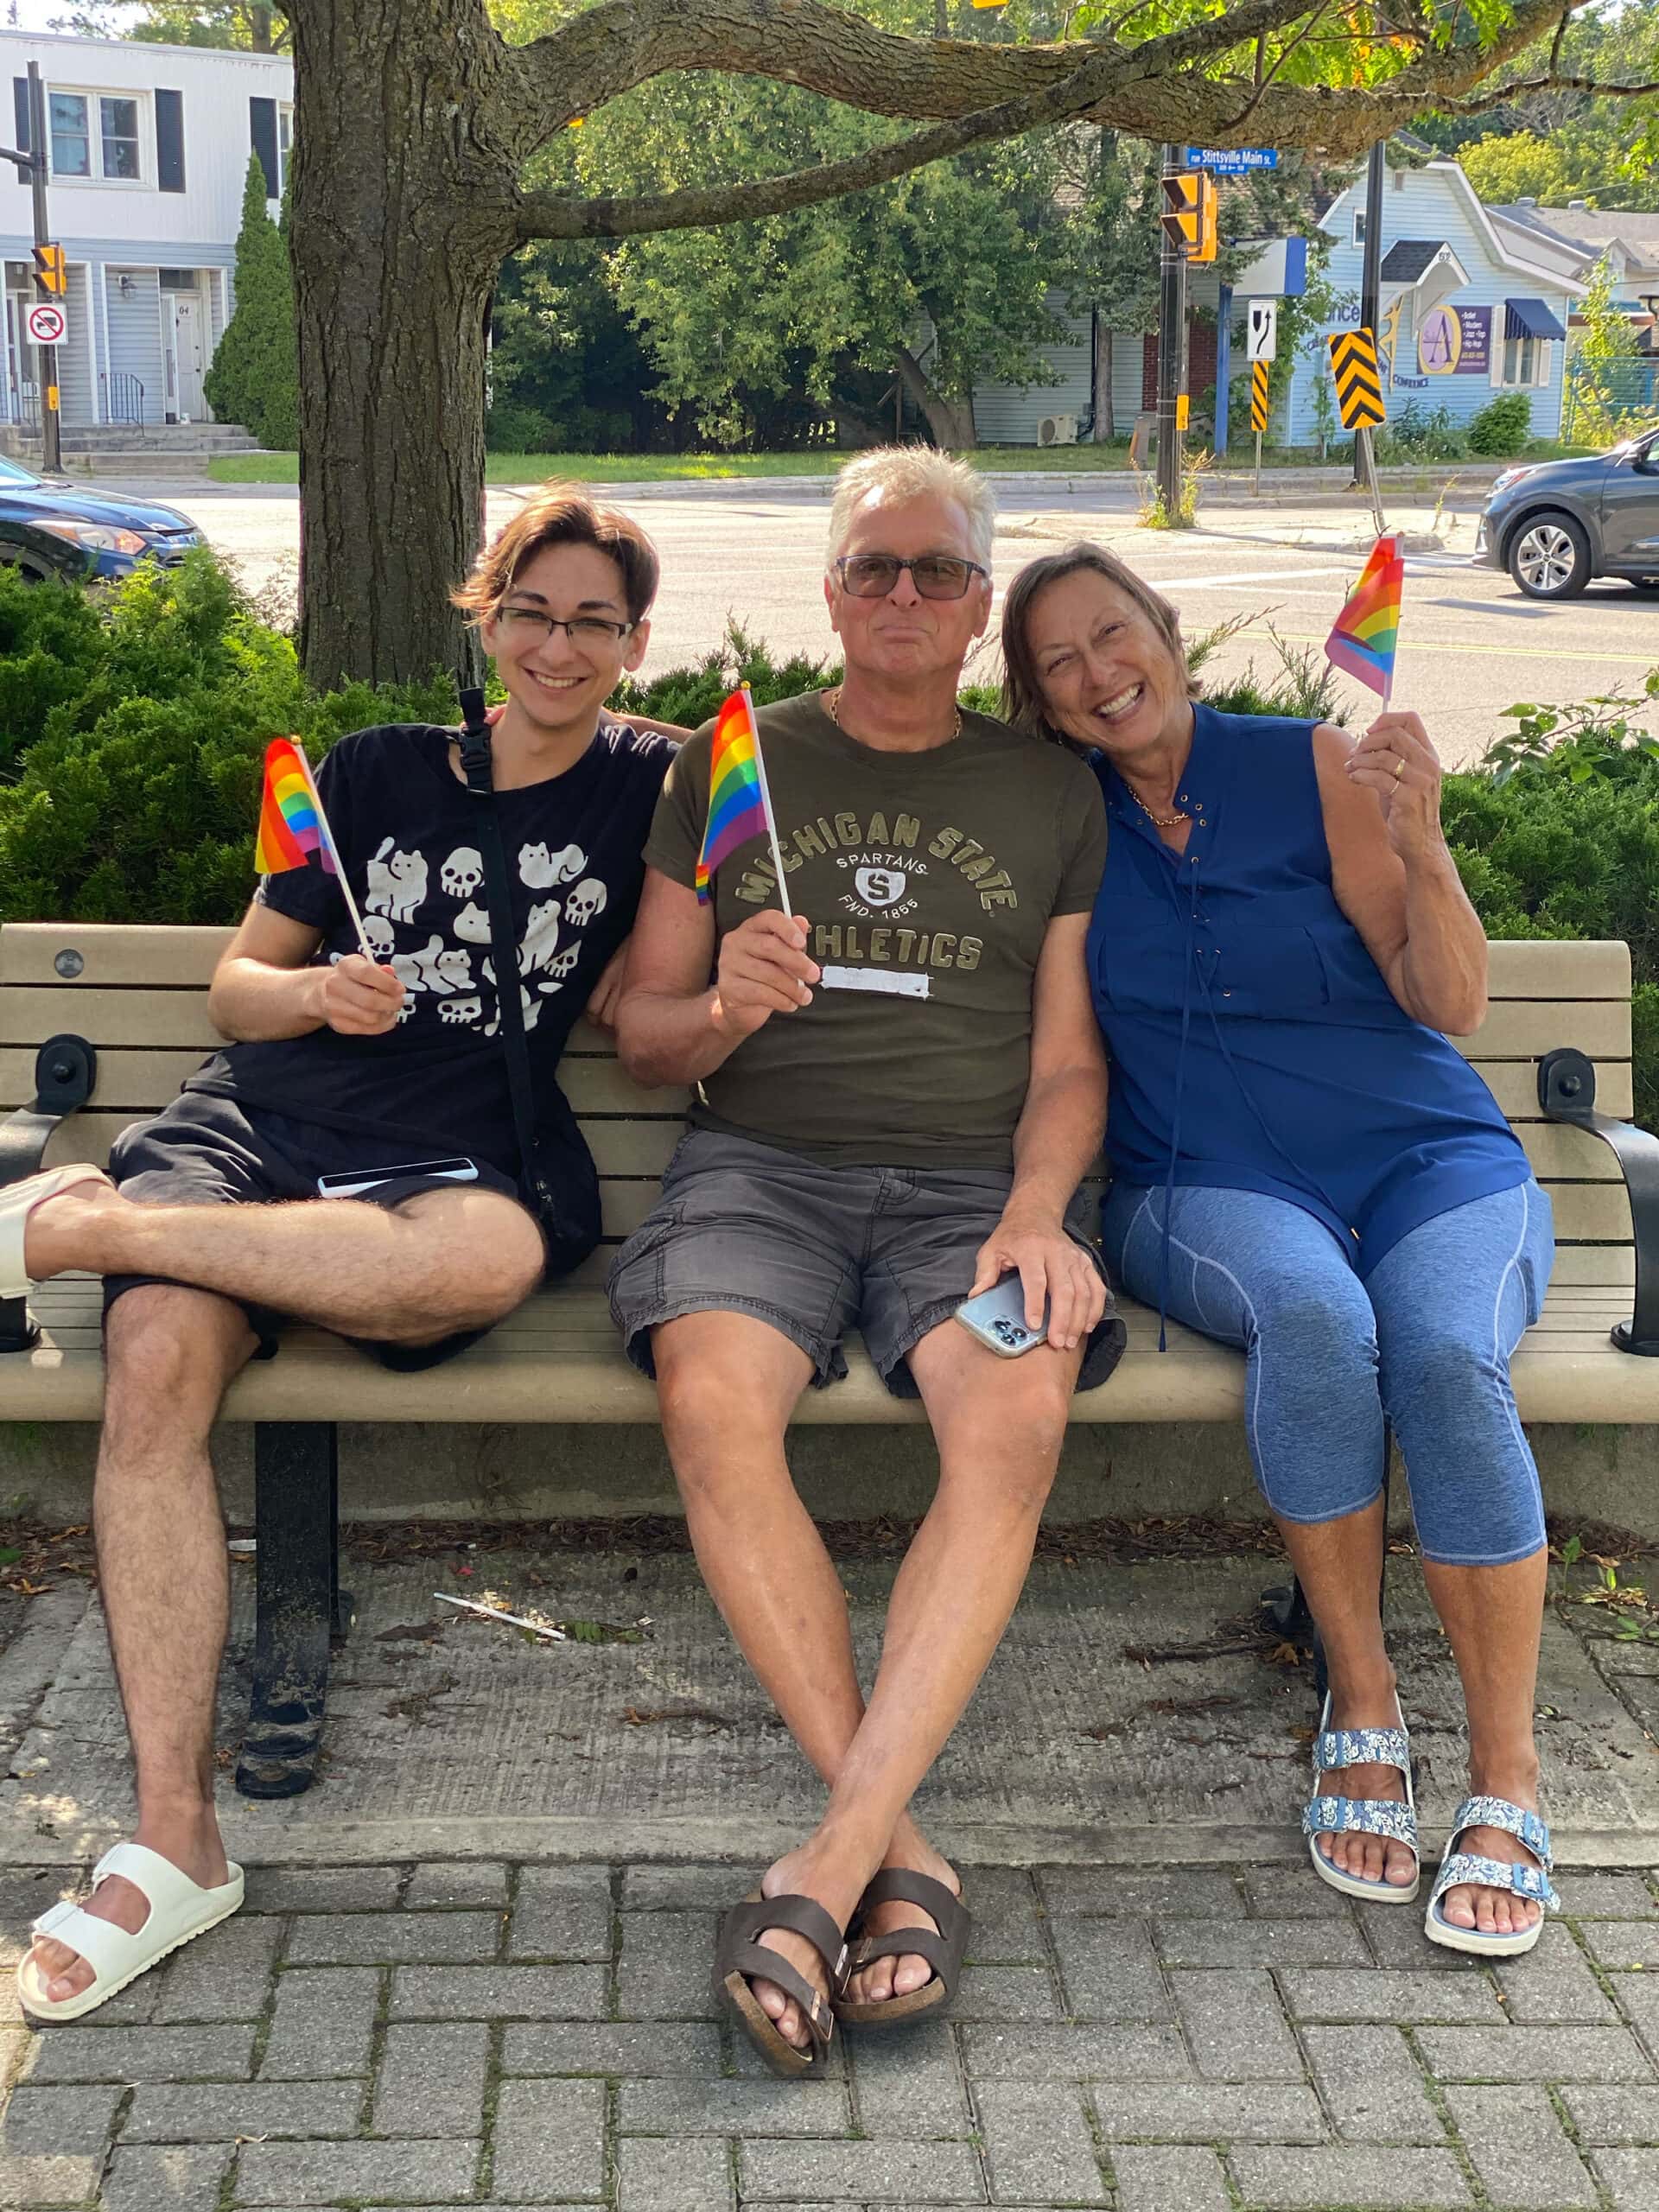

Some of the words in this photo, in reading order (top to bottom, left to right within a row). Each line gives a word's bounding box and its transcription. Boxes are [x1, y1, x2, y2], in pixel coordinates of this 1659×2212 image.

[1202, 149, 1240, 163] Stittsville
[1243, 150, 1262, 164] Main
[735, 812, 919, 904] MICHIGAN
[928, 827, 1018, 910] STATE
[836, 852, 927, 874] SPARTANS
